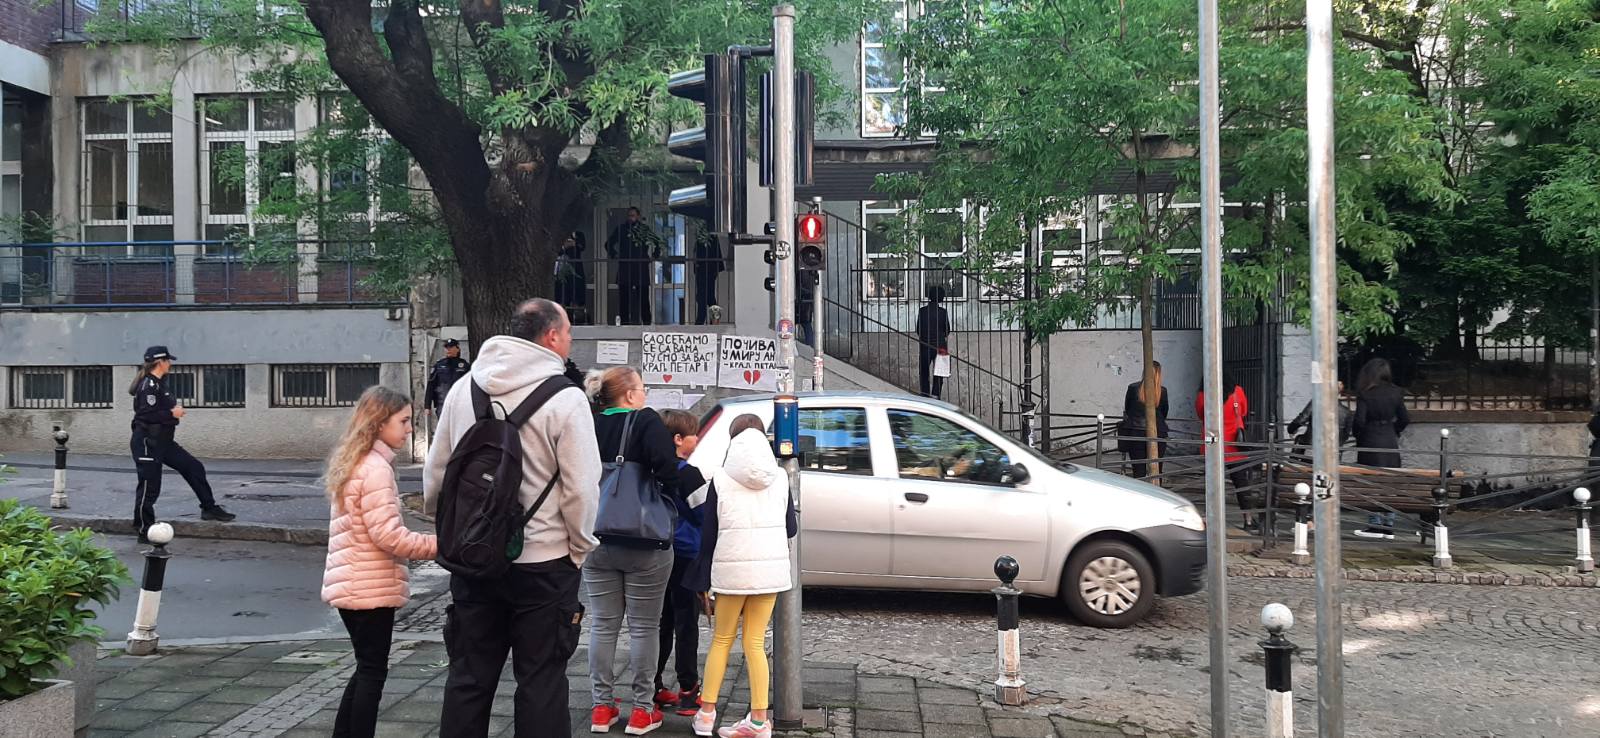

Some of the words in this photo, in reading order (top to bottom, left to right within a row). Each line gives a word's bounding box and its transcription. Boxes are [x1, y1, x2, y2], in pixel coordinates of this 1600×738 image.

[643, 334, 708, 344] САОСЕЋАМО
[643, 344, 656, 353] СЕ
[659, 344, 670, 353] СА
[673, 343, 699, 353] ВАМА
[725, 338, 775, 351] ПОЧИВА
[643, 353, 655, 362] ТУ
[658, 352, 678, 362] СМО
[681, 353, 691, 361] ЗА
[763, 351, 776, 361] АН
[671, 362, 701, 372] ПЕТАР
